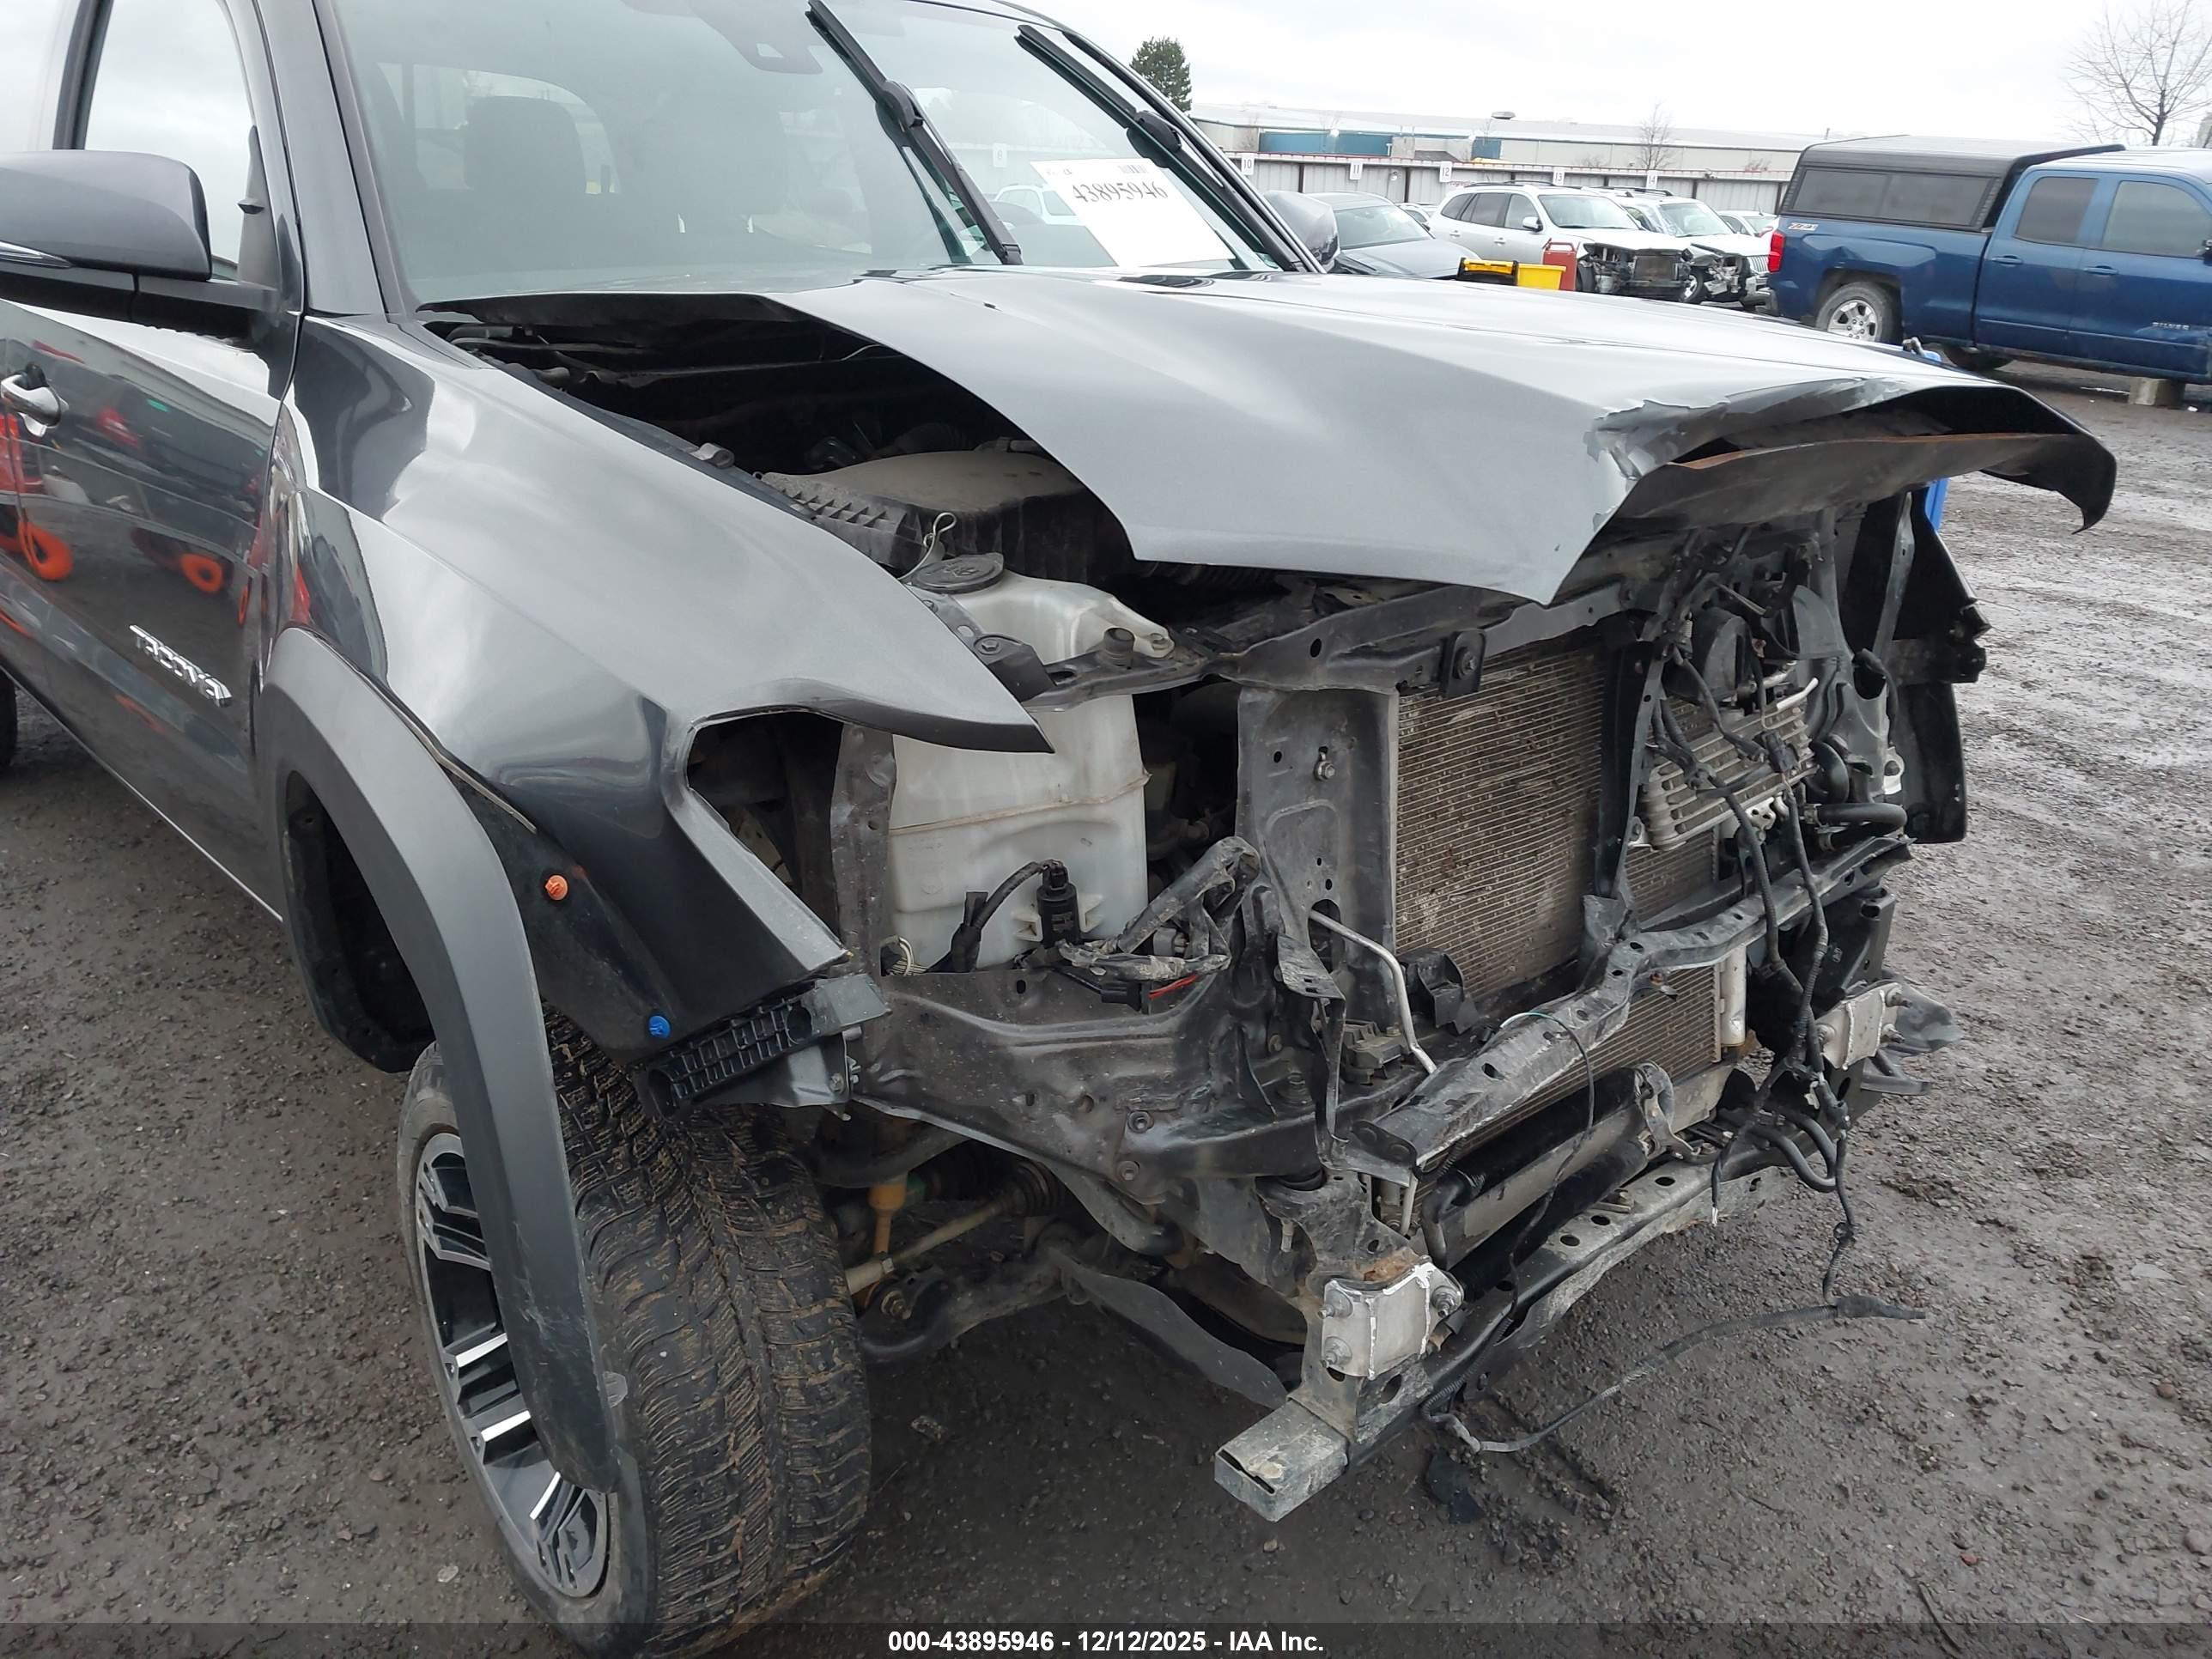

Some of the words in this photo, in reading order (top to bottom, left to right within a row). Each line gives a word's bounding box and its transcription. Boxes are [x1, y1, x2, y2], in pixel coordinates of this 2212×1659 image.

[1243, 159, 1252, 169] 10
[1352, 164, 1360, 174] 11
[1442, 167, 1450, 177] 12
[1554, 172, 1563, 183] 13
[1648, 175, 1656, 185] 14
[1073, 181, 1169, 203] 43895946
[129, 625, 232, 707] TACOMA
